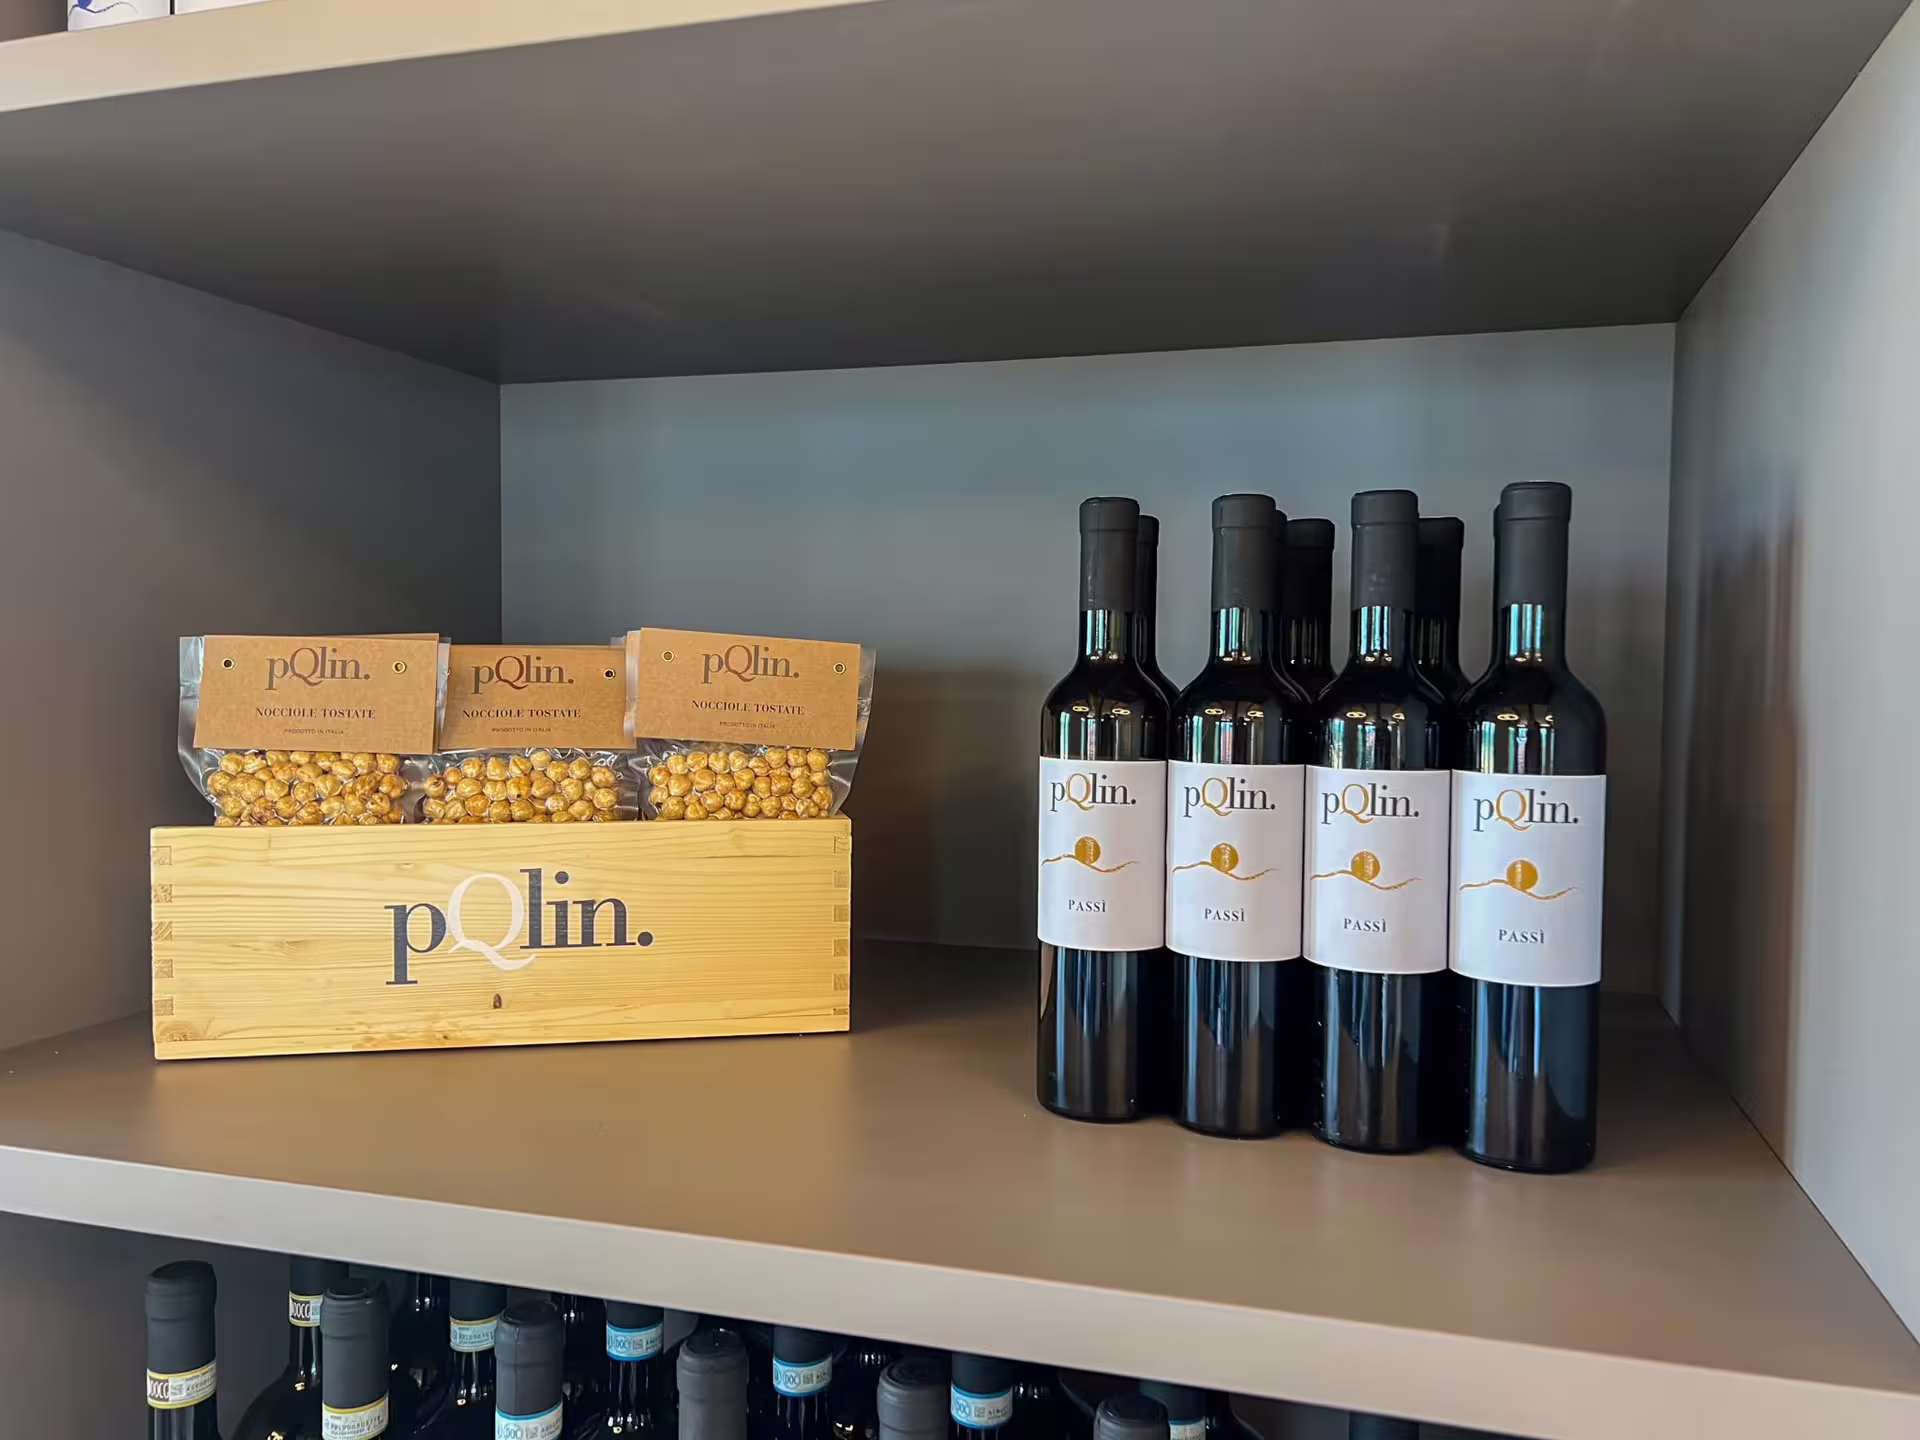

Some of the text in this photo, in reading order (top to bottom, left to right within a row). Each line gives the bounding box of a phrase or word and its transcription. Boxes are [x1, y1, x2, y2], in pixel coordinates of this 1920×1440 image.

[264, 646, 370, 691] pQlin.
[471, 654, 575, 695] pQlin.
[700, 644, 800, 685] pQlin.
[255, 707, 376, 719] NOCCIOLE TOSTATE
[462, 708, 581, 719] NOCCIOLE TOSTATE
[692, 699, 805, 715] NOCCIOLE TOSTATE
[1050, 772, 1137, 812] pQlin.
[1183, 776, 1276, 818] pQlin.
[1320, 782, 1420, 825] pQlin.
[1473, 788, 1579, 832] pQlin.
[1068, 898, 1107, 913] PASSÌ
[1204, 907, 1246, 922] PASSÌ
[1343, 917, 1387, 933] PASSÌ
[384, 867, 655, 986] pQlin.
[1497, 928, 1545, 944] PASSÌ
